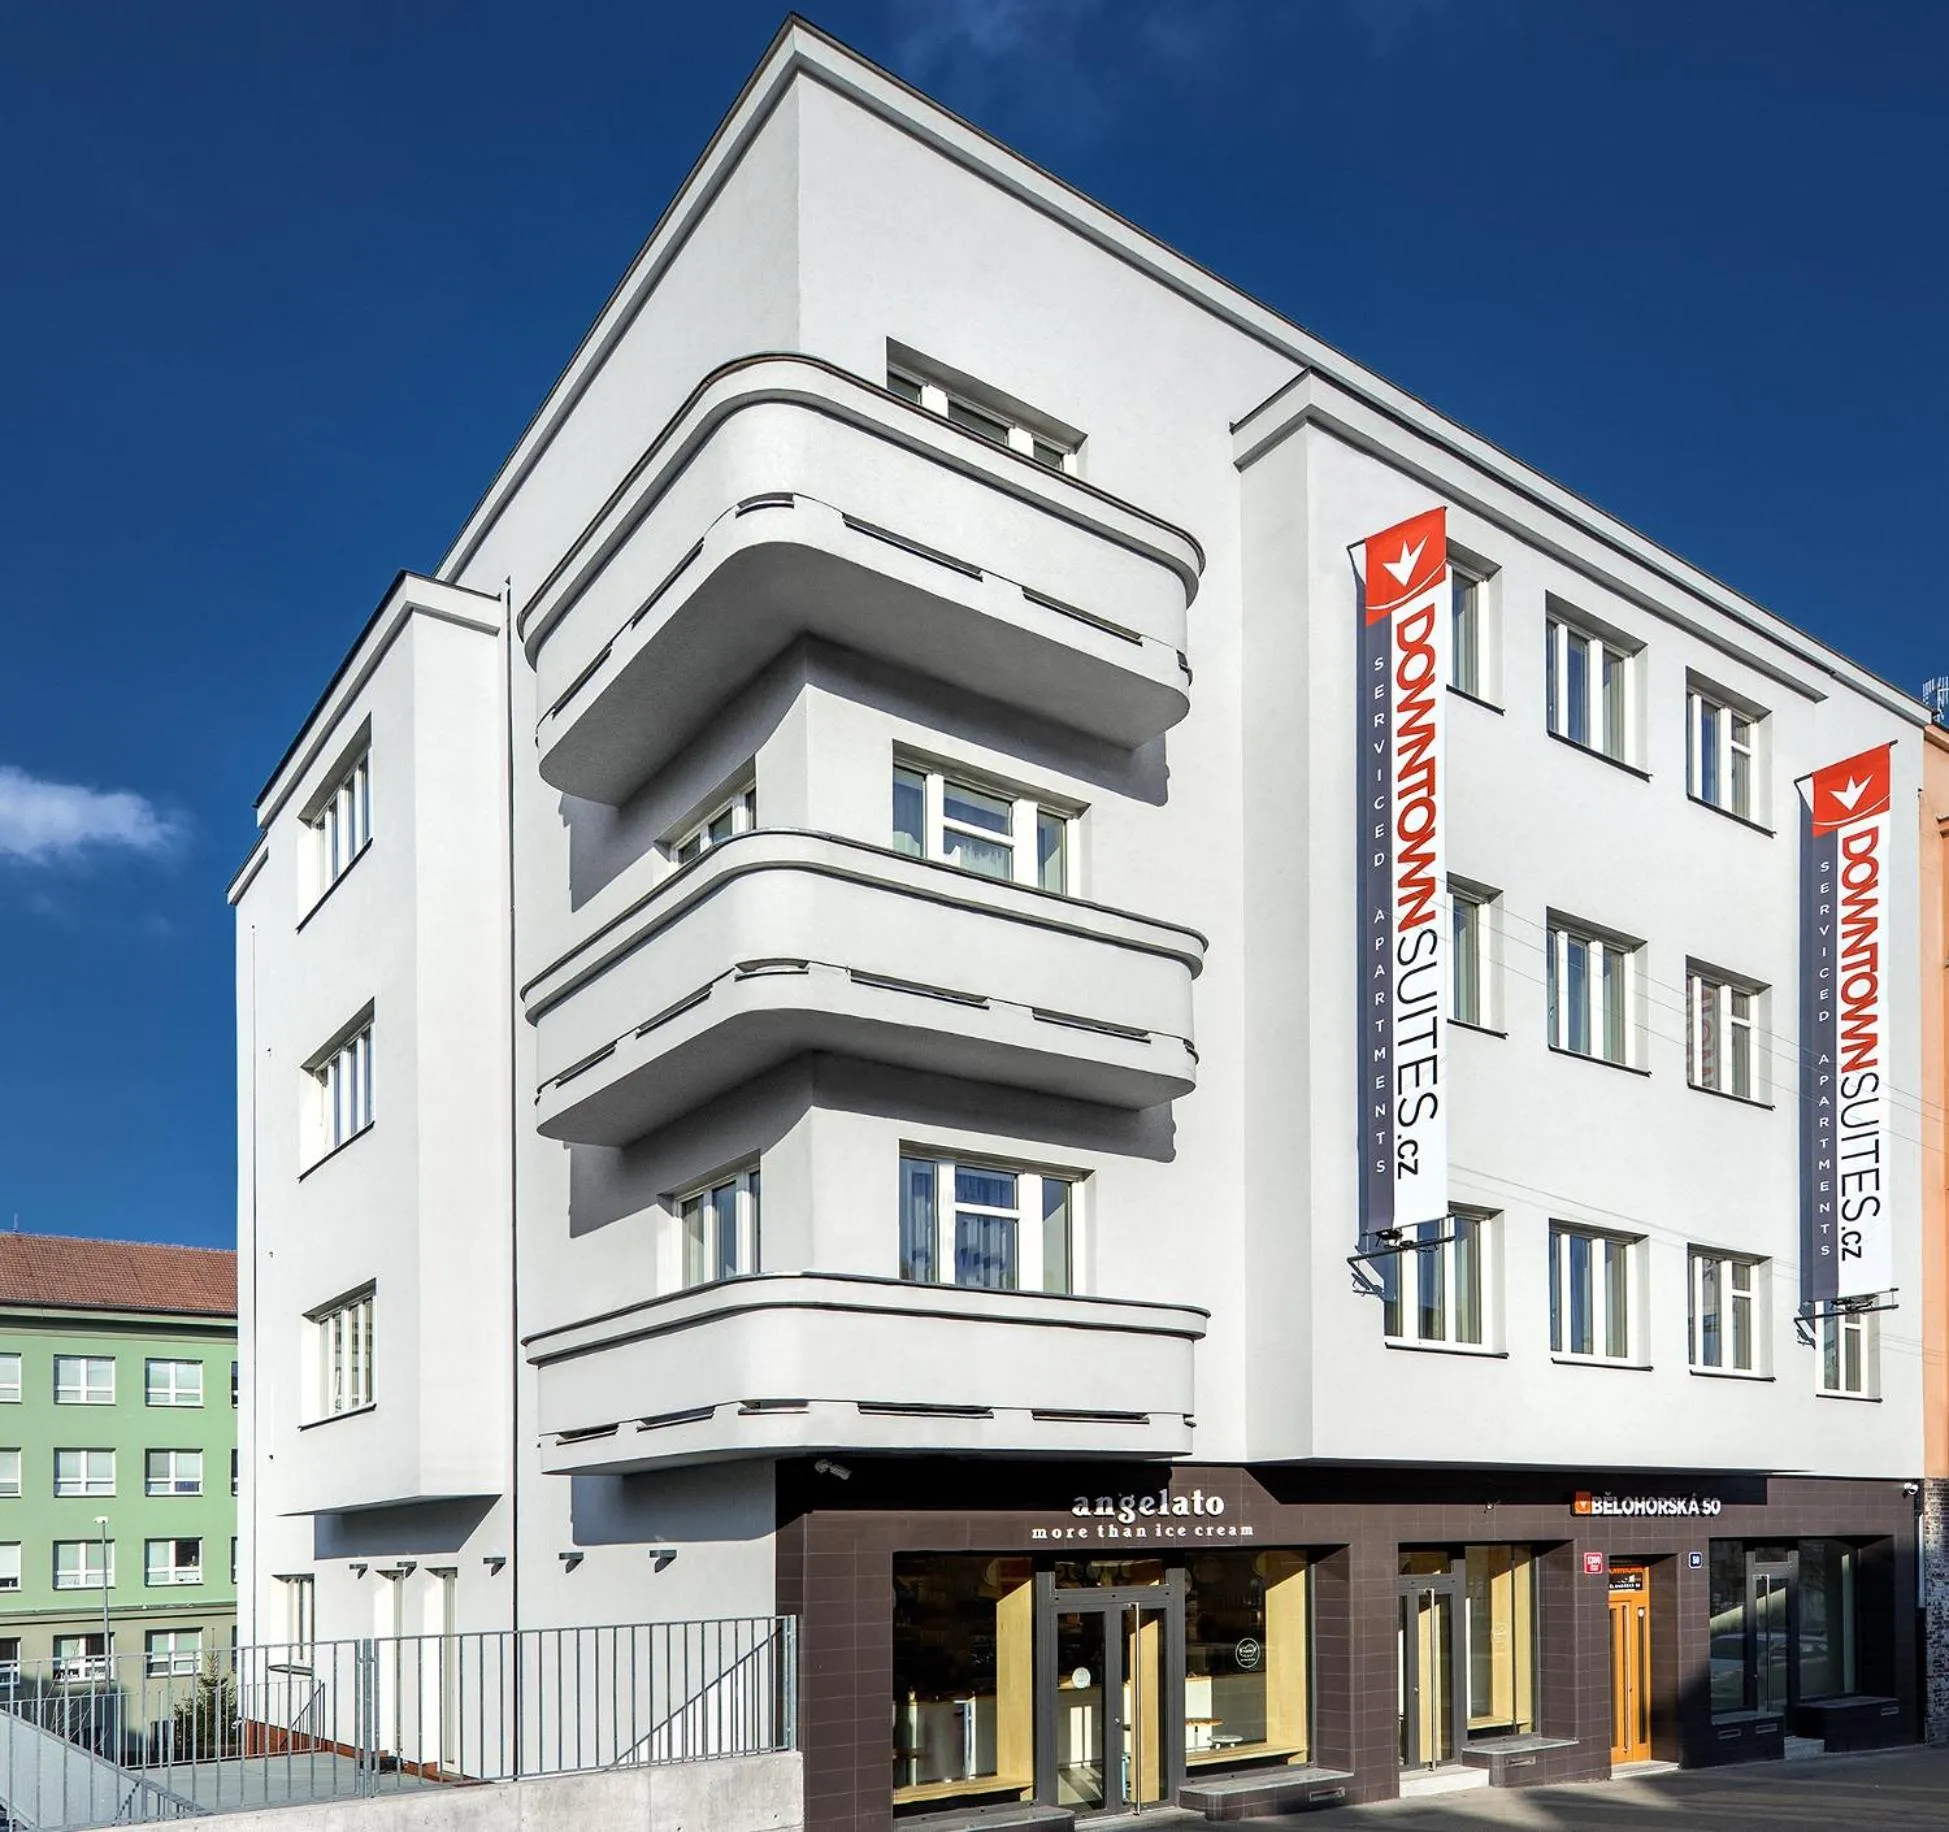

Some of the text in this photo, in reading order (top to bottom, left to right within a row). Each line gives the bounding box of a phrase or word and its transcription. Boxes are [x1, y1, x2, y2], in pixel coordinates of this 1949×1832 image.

[1373, 656, 1386, 1173] SERVICED APARTMENTS
[1818, 861, 1831, 1256] SERVICED APARTMENTS
[1071, 1488, 1225, 1523] angelato
[1592, 1491, 1721, 1515] BĚLOHORSKÁ 50
[1031, 1523, 1254, 1539] more than ice cream
